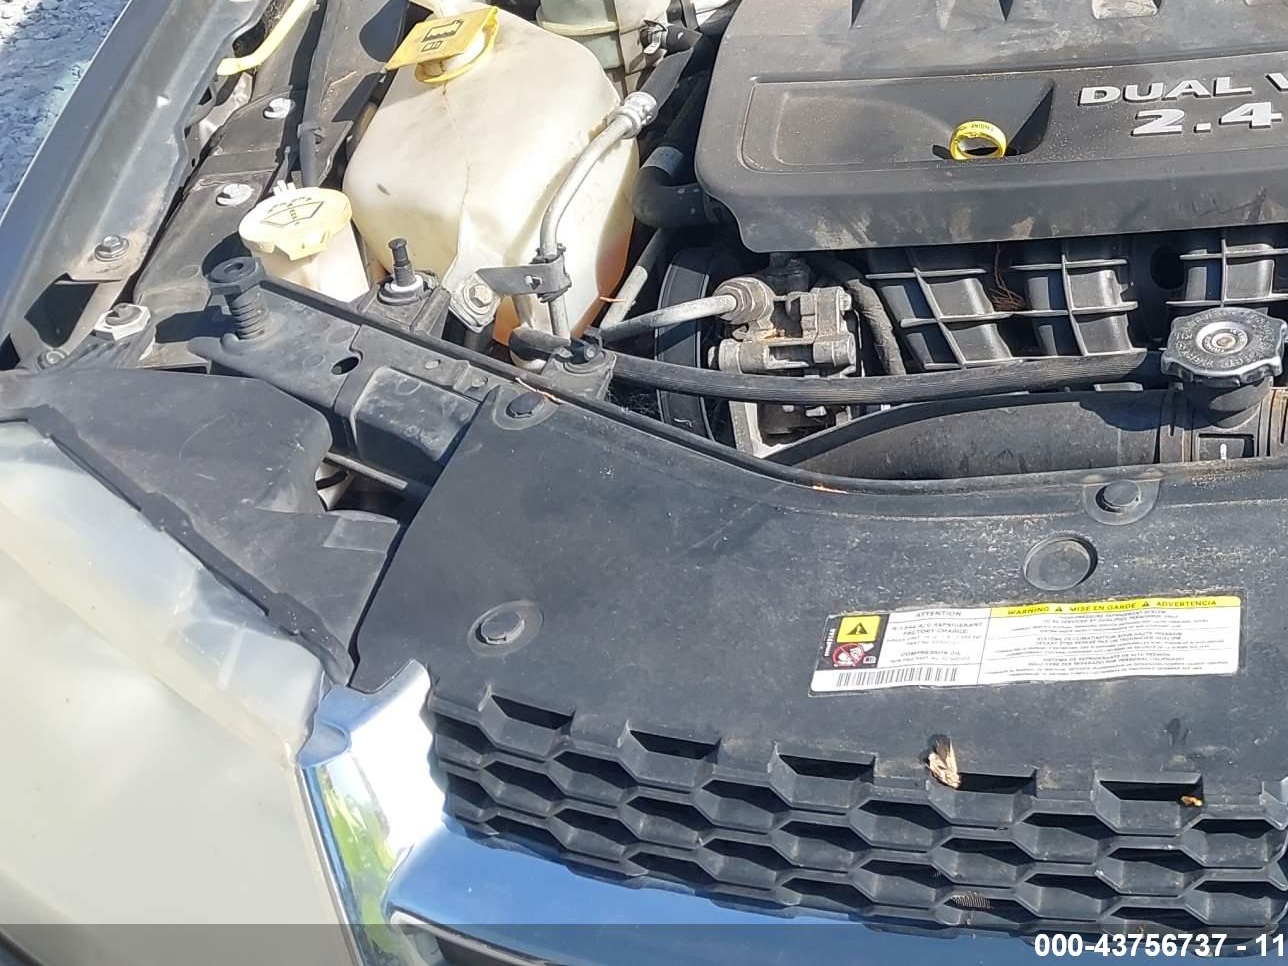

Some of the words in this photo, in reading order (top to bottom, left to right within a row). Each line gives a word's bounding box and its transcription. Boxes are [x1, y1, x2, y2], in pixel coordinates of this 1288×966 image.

[1078, 76, 1253, 105] DUAL
[914, 610, 962, 618] ATTENTION
[1008, 606, 1050, 616] WARNING
[1106, 603, 1137, 611] GARDE
[1156, 599, 1217, 608] ADVERTENCIA
